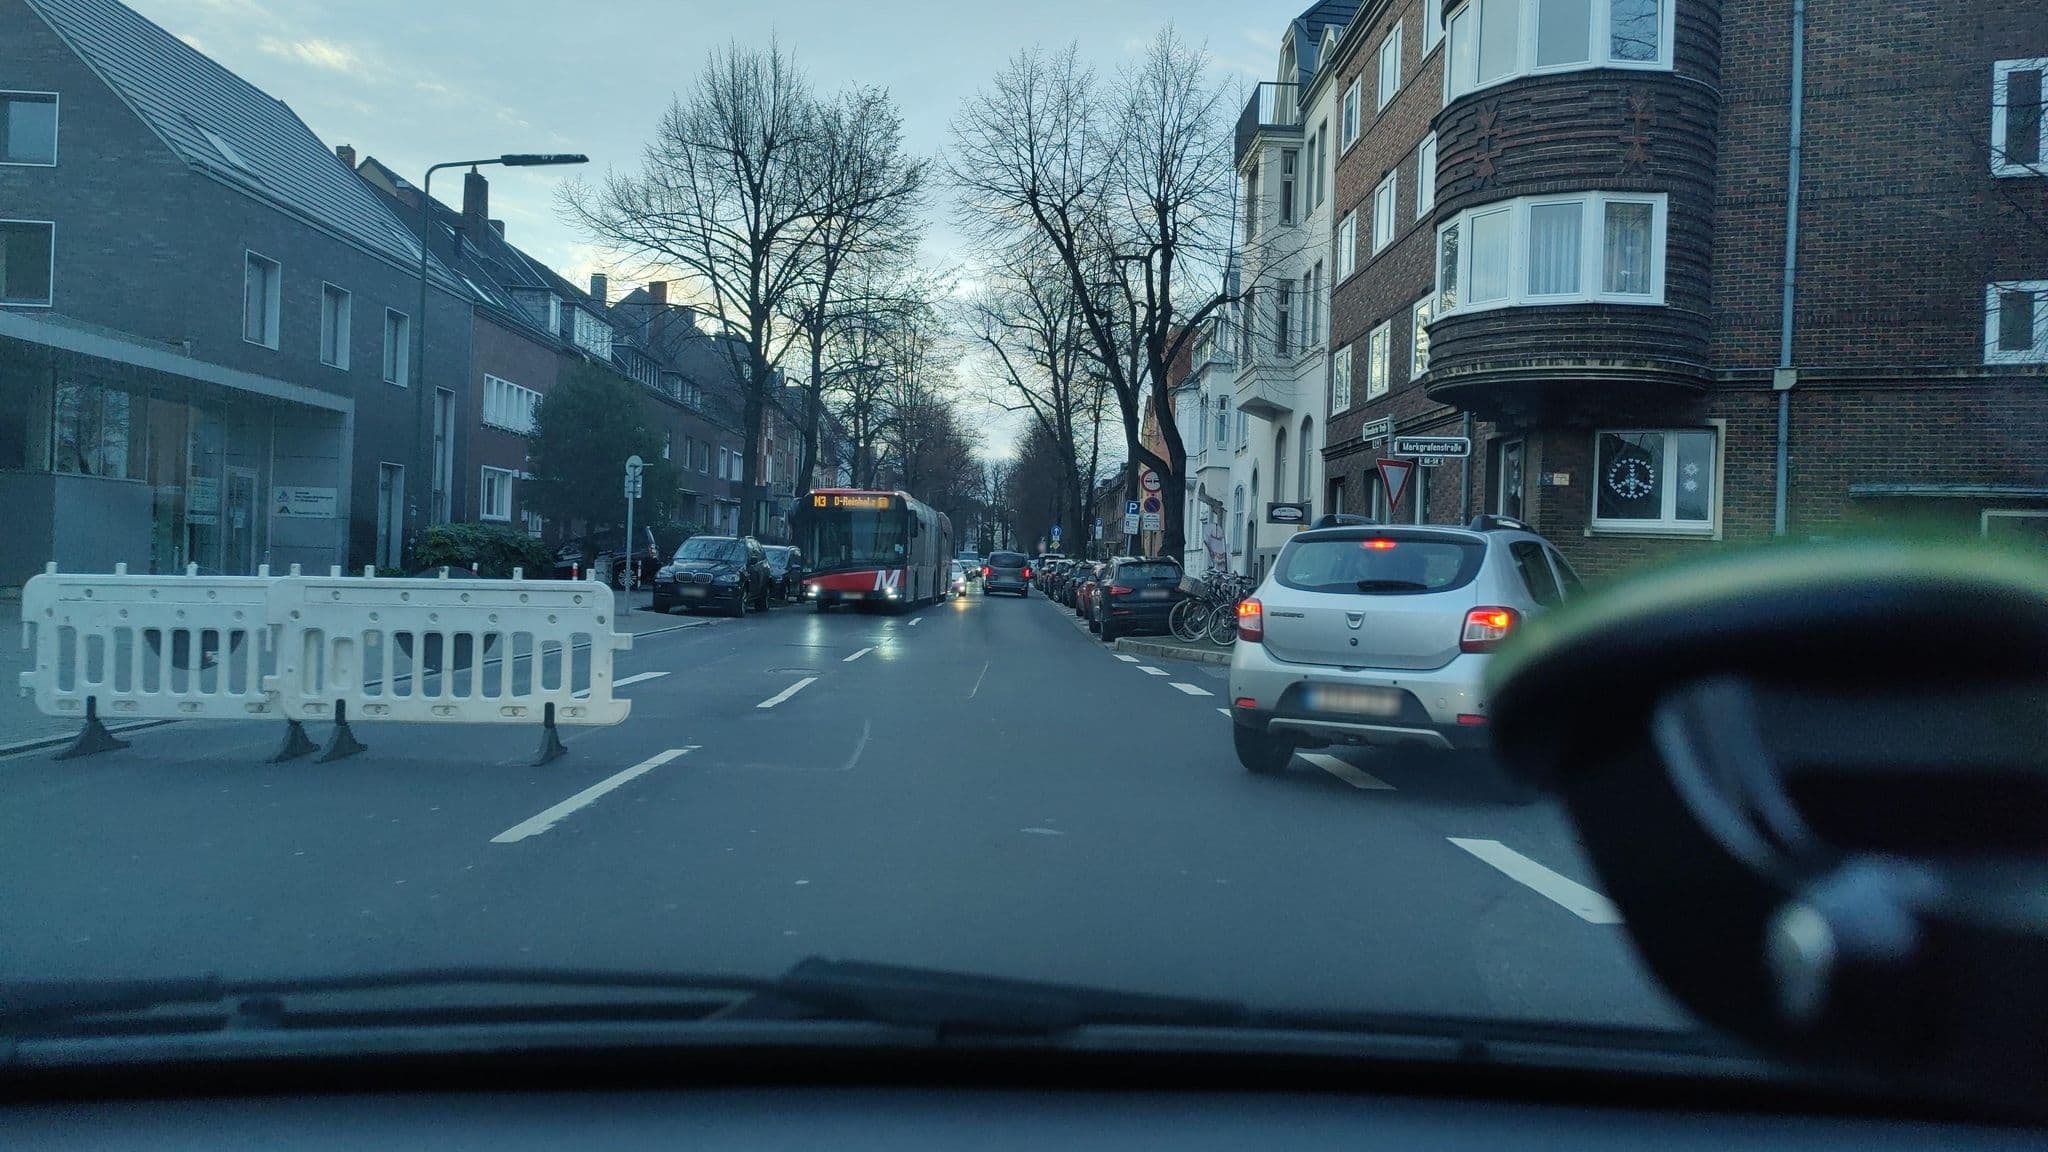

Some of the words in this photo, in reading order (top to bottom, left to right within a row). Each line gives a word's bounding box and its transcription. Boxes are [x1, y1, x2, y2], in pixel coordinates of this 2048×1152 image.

[1402, 442, 1462, 453] Markgrafenstraße
[814, 496, 827, 507] M3
[1129, 503, 1138, 514] P
[874, 569, 901, 591] M
